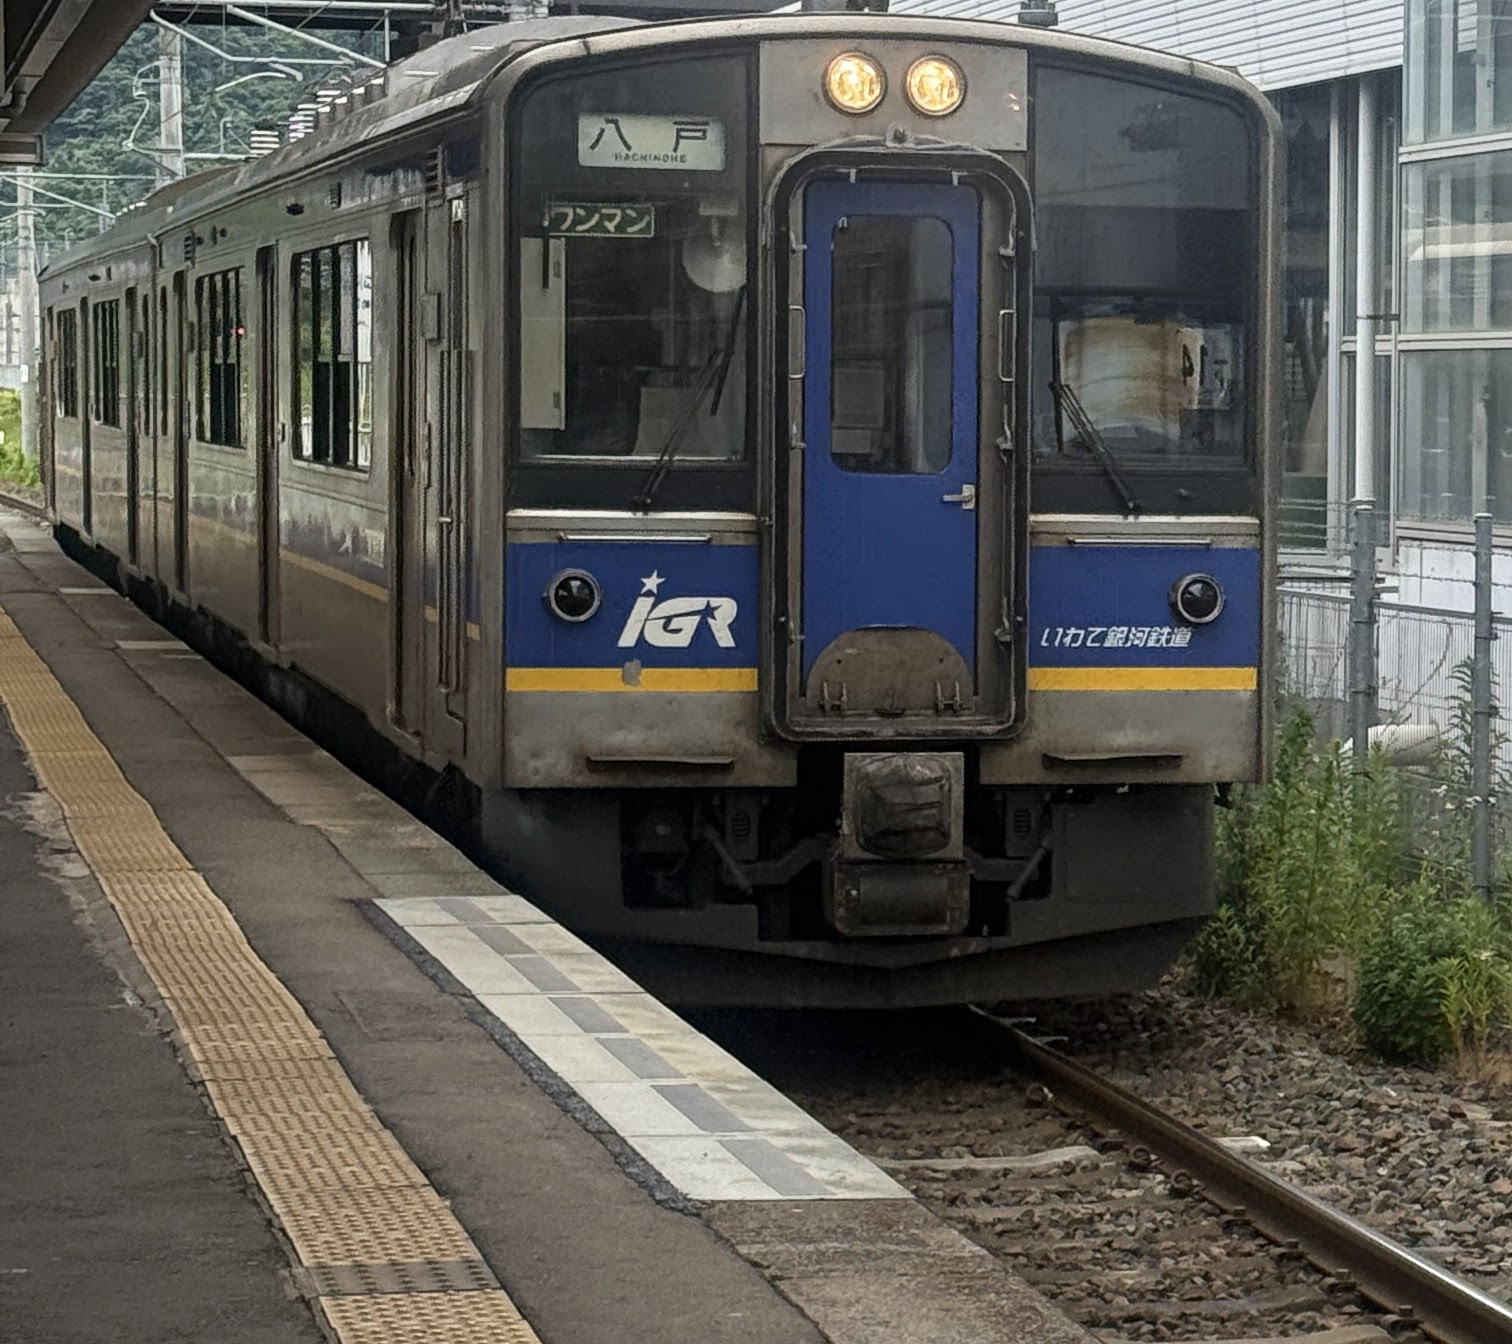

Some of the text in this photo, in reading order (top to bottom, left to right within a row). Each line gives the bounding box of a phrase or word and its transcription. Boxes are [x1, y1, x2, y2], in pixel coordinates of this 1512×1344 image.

[588, 118, 710, 153] 八戸
[614, 152, 688, 164] HACHINOHE
[551, 207, 650, 233] ワンマン
[1040, 626, 1192, 648] いわて銀河鉄道
